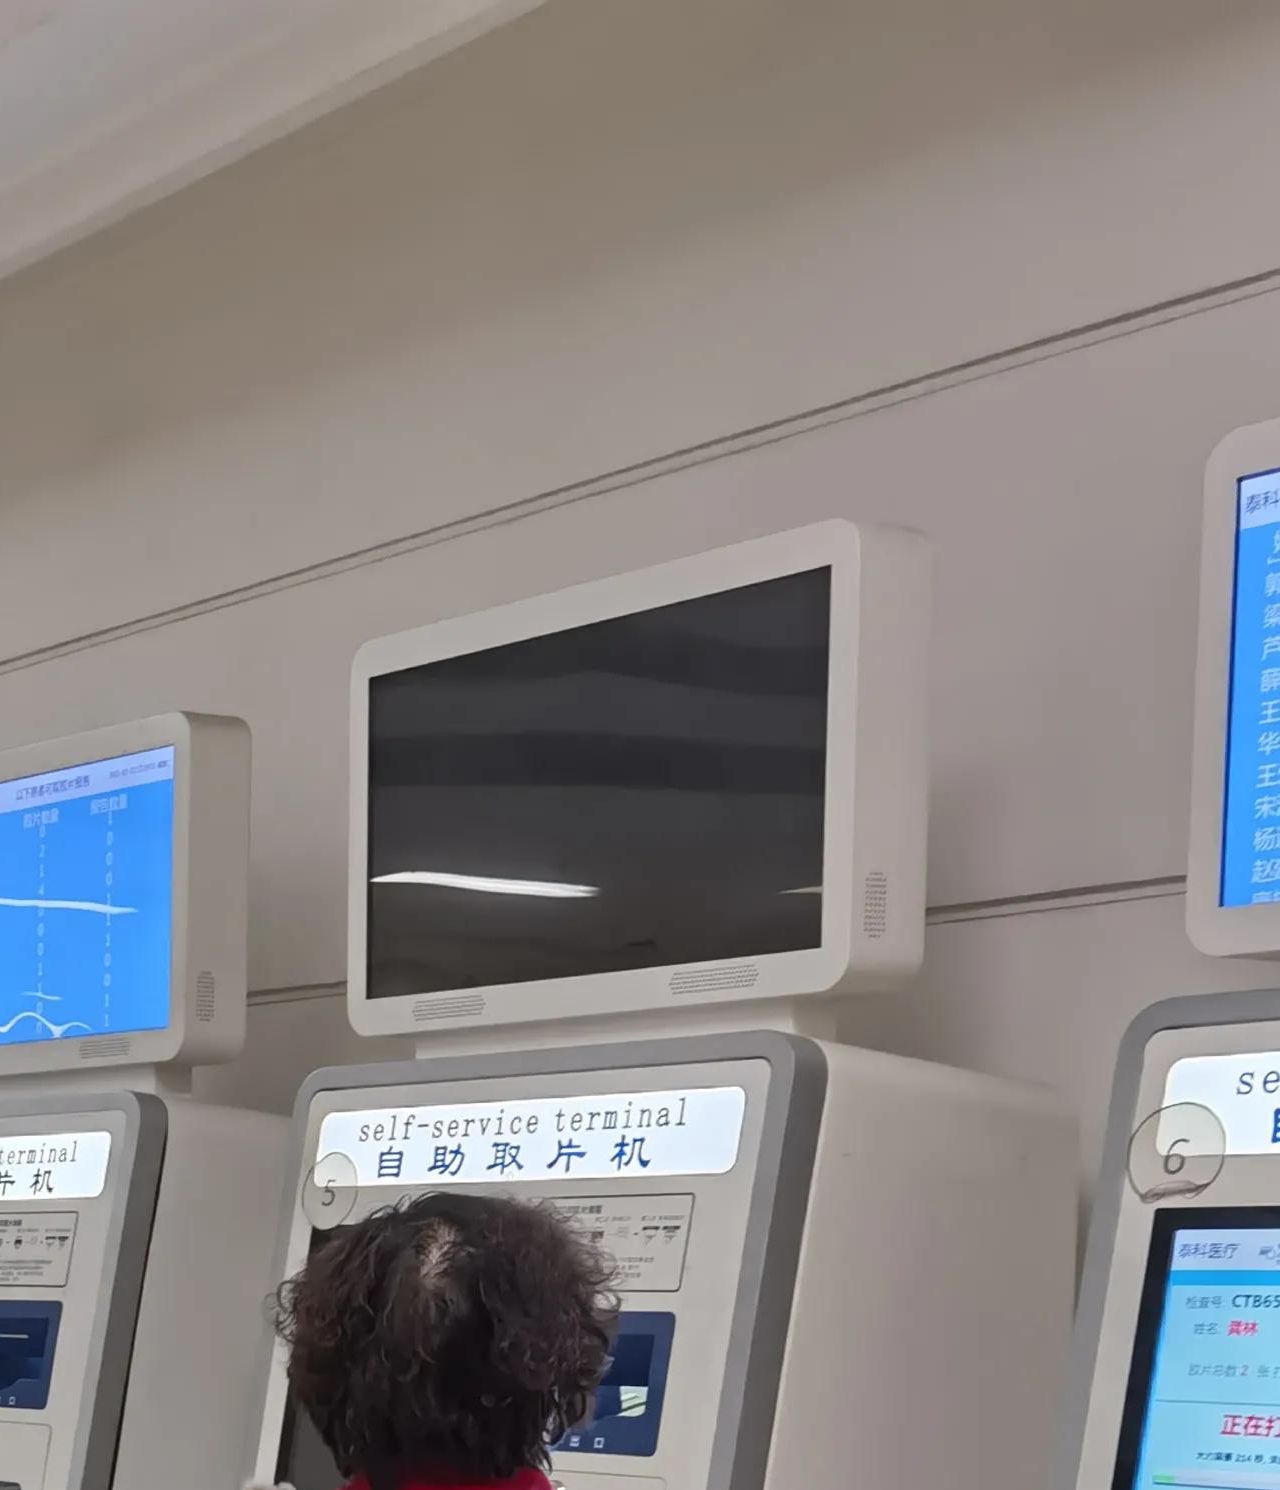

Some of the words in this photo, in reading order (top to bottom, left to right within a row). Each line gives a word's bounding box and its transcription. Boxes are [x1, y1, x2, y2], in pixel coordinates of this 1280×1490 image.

[359, 1110, 539, 1143] self-service
[555, 1097, 688, 1132] terminal
[376, 1135, 652, 1179] 自助取片机
[1163, 1138, 1190, 1174] 6
[321, 1179, 337, 1207] 5
